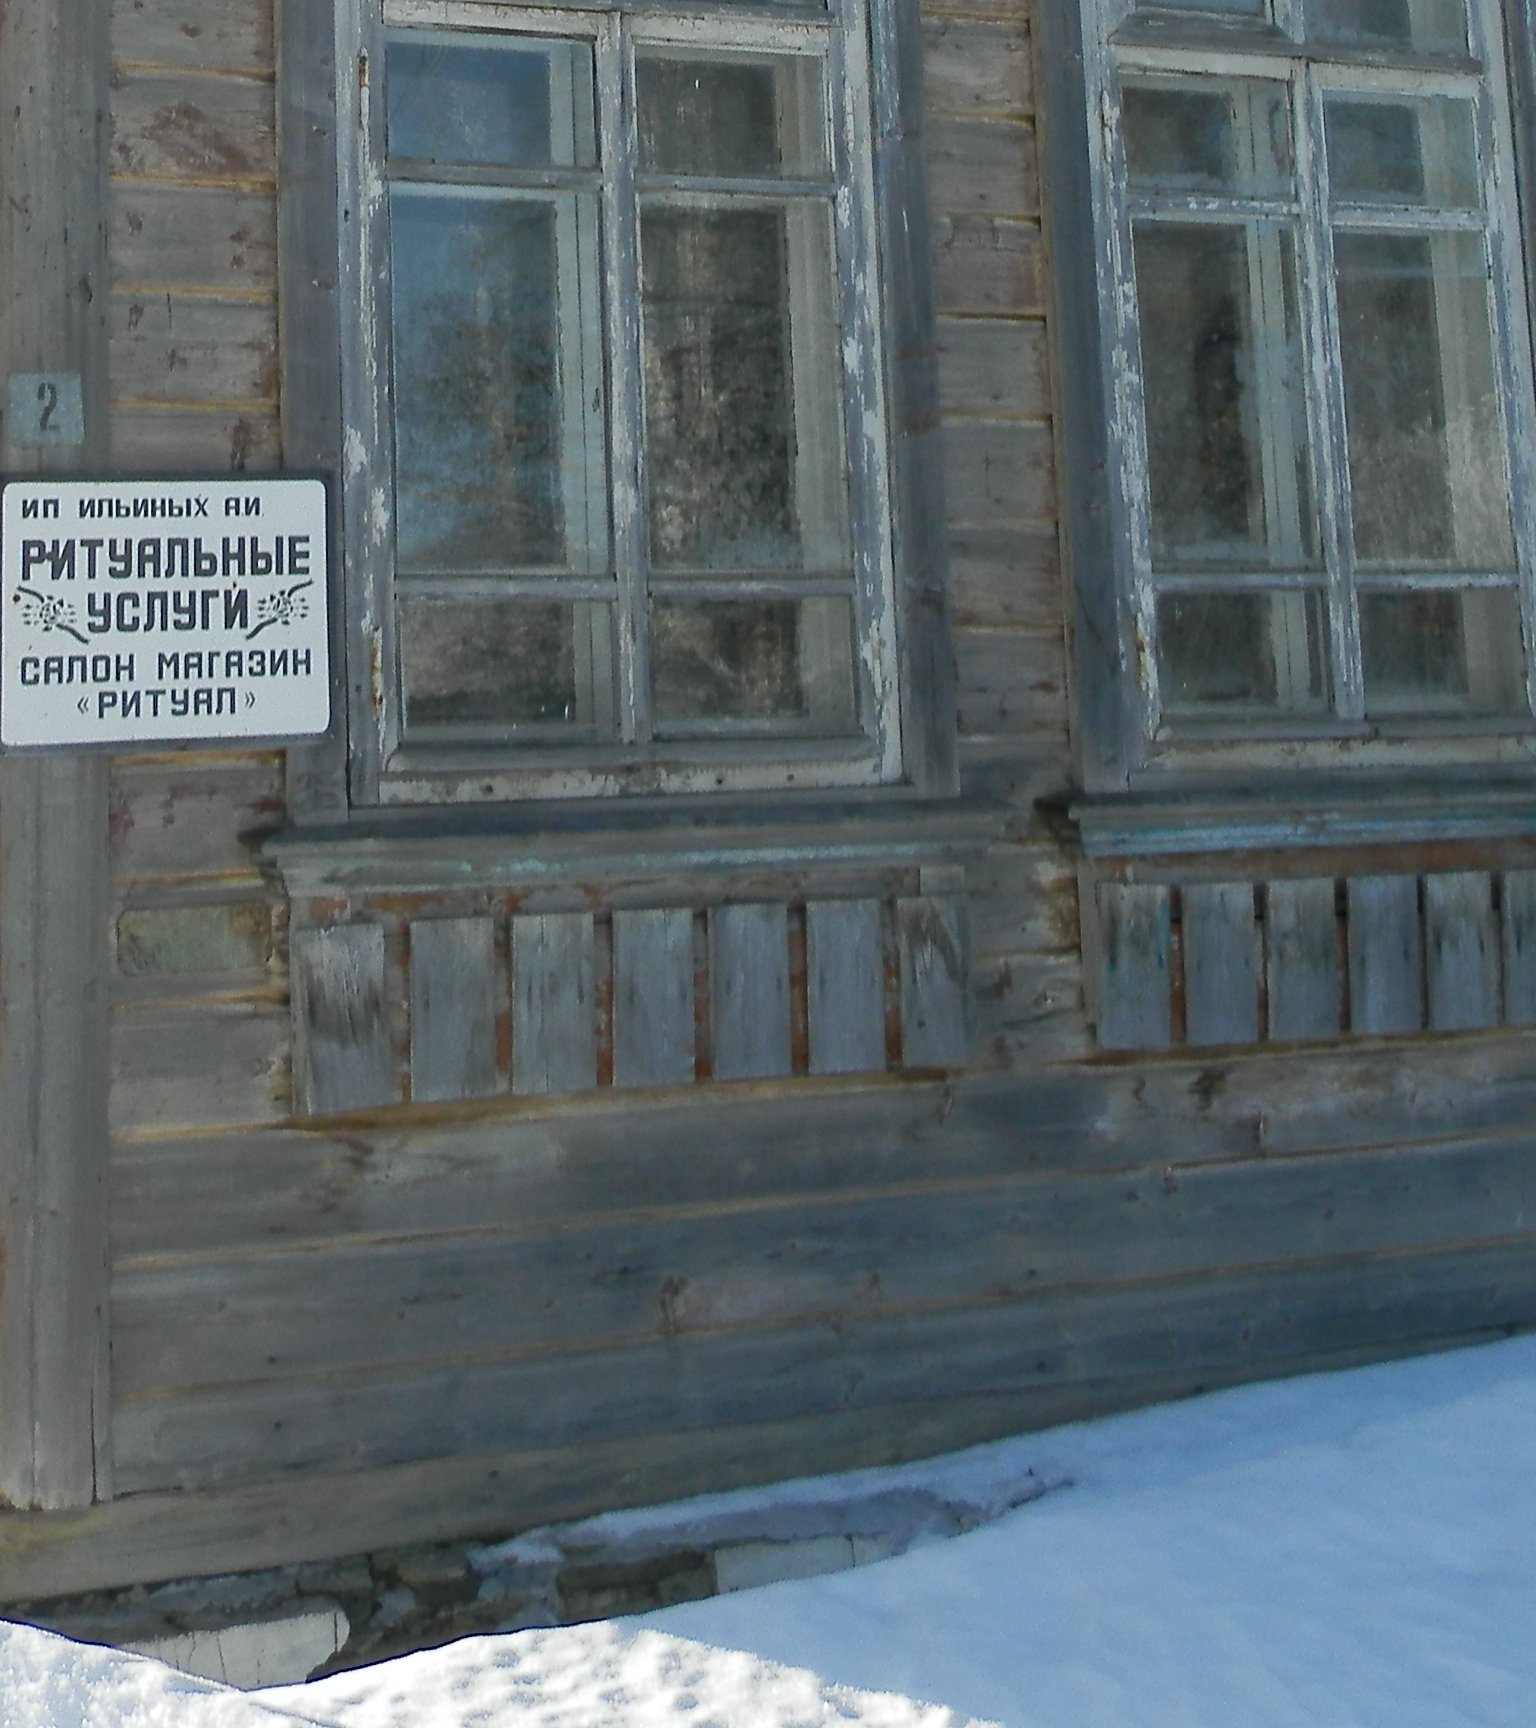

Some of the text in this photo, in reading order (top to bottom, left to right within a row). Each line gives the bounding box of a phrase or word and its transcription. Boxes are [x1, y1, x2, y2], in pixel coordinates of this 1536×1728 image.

[37, 382, 59, 432] 2
[22, 498, 60, 519] ИП
[79, 498, 208, 518] ИЛЬИНЫХ
[21, 536, 310, 581] РИТУАЛЬНЫЕ
[87, 589, 249, 633] УСЛУГИ
[21, 649, 312, 686] САЛОН МАГАЗИН
[77, 688, 256, 719] «РИТУАЛ»
